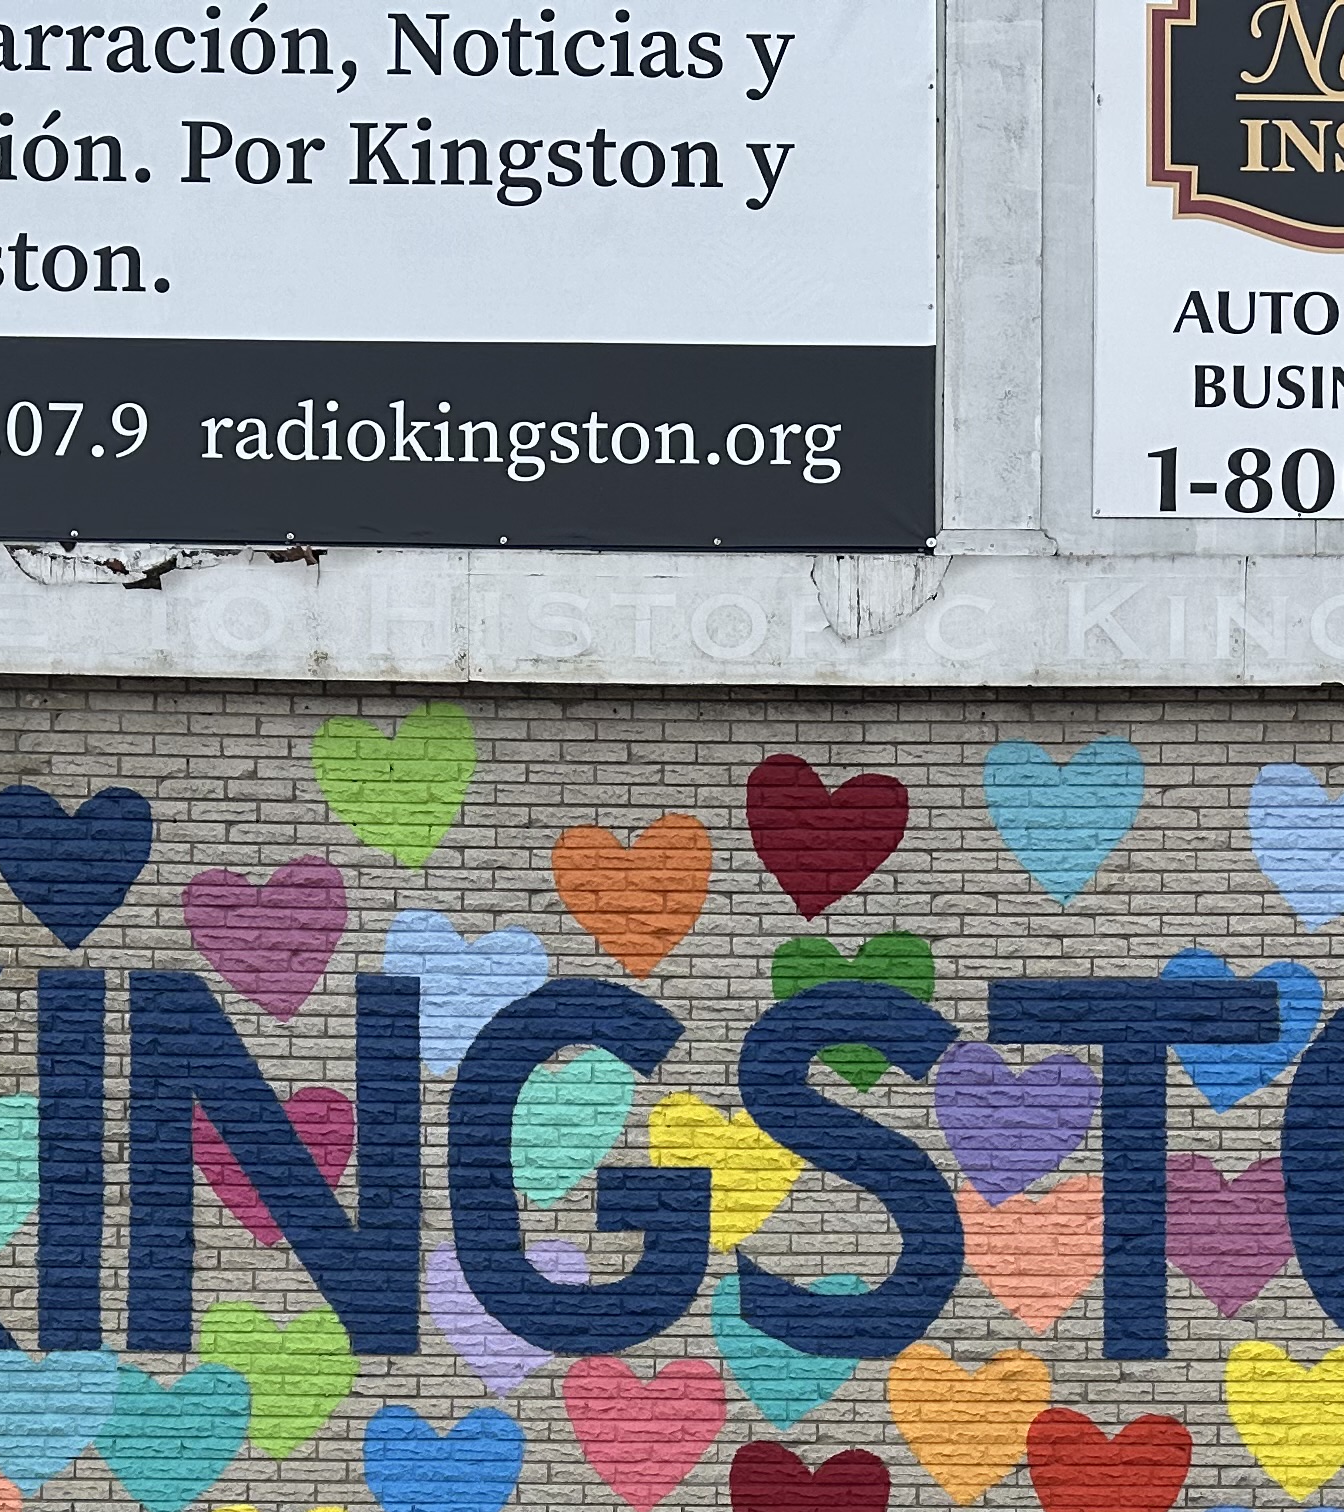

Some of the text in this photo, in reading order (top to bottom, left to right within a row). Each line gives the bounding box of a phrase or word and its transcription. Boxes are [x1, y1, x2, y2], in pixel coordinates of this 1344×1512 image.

[387, 9, 723, 78] Noticias
[746, 33, 796, 100] y
[181, 121, 325, 185] Por
[349, 117, 723, 207] Kingston
[746, 143, 796, 210] y
[1173, 291, 1340, 335] AUTO
[201, 399, 842, 484] radiokingston.org
